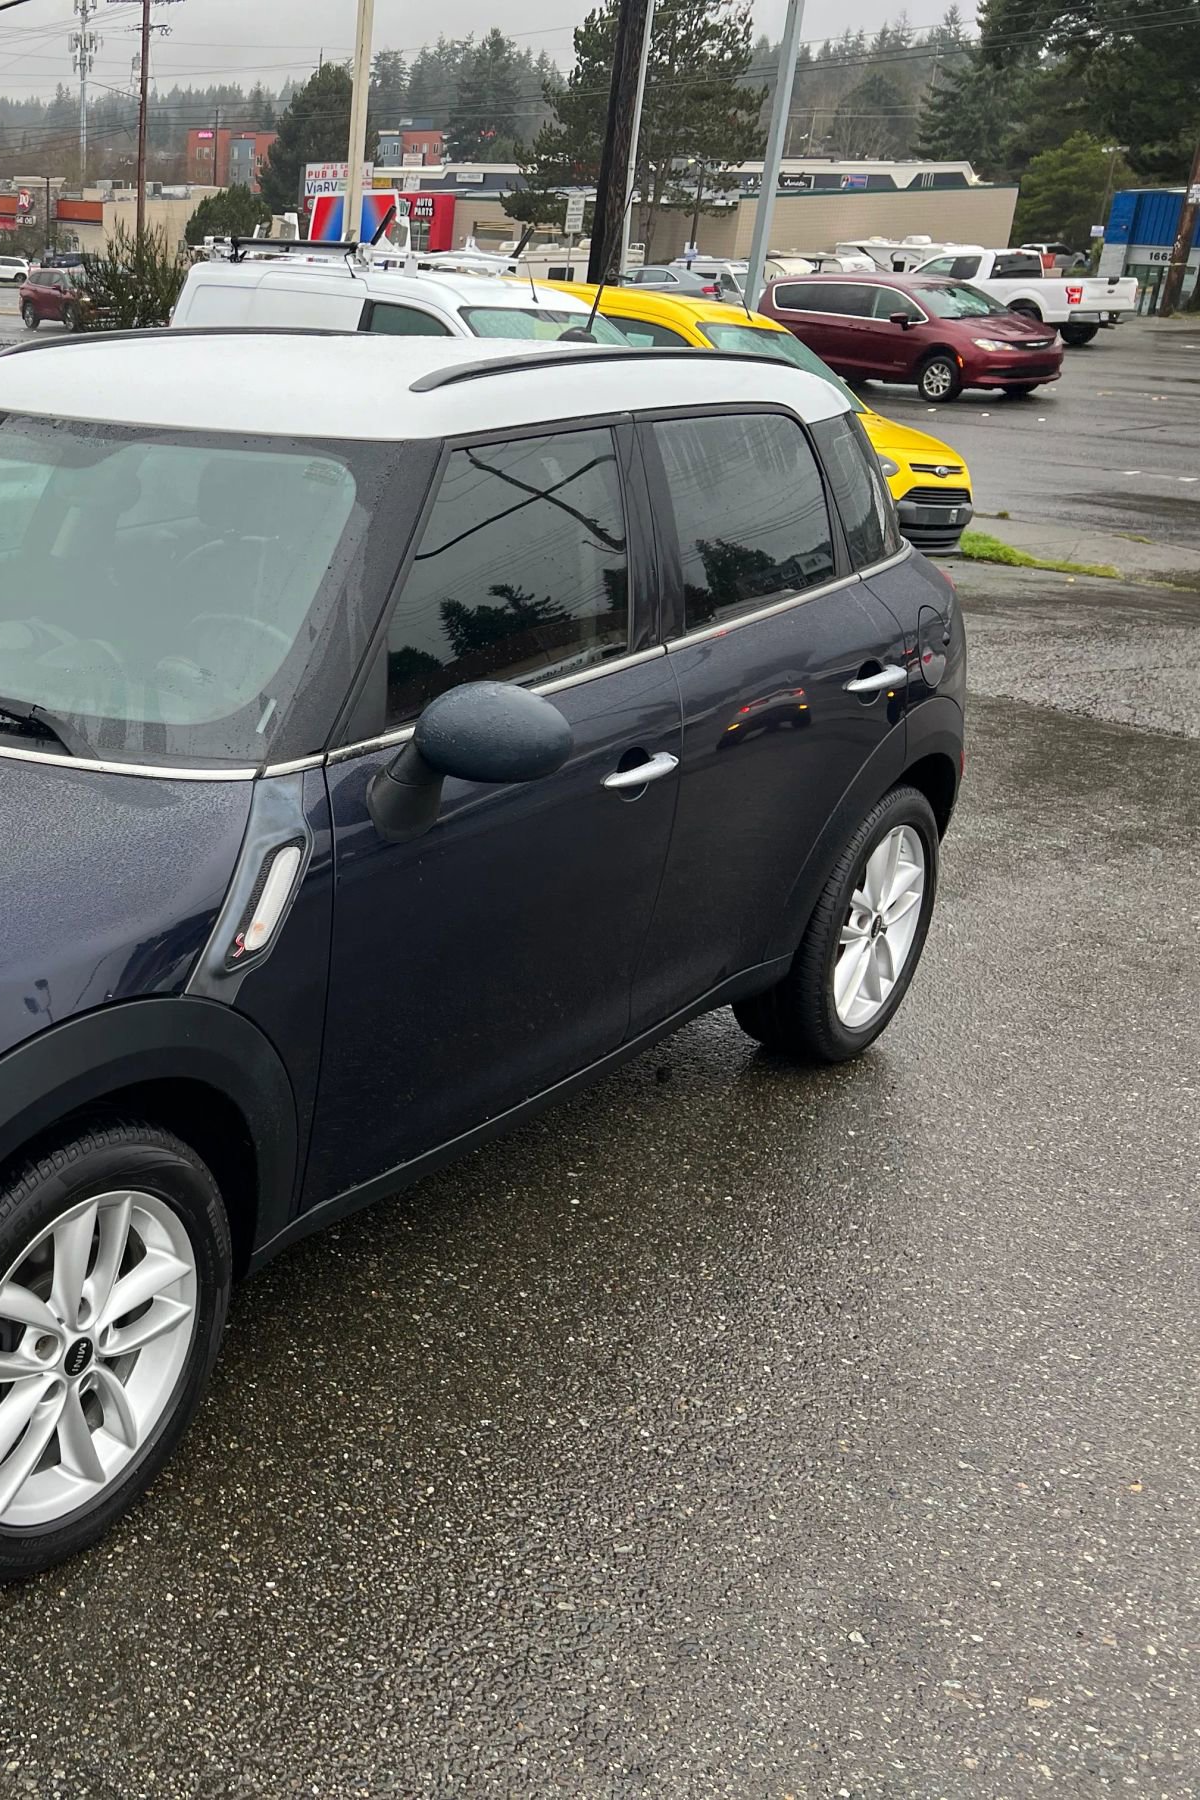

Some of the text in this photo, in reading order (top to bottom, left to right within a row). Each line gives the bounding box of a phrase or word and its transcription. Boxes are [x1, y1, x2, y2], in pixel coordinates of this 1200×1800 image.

[307, 170, 327, 179] PUB
[306, 181, 338, 194] ViaRV
[416, 198, 433, 207] AUTO
[414, 207, 433, 216] PARTS
[71, 1342, 88, 1372] MINI
